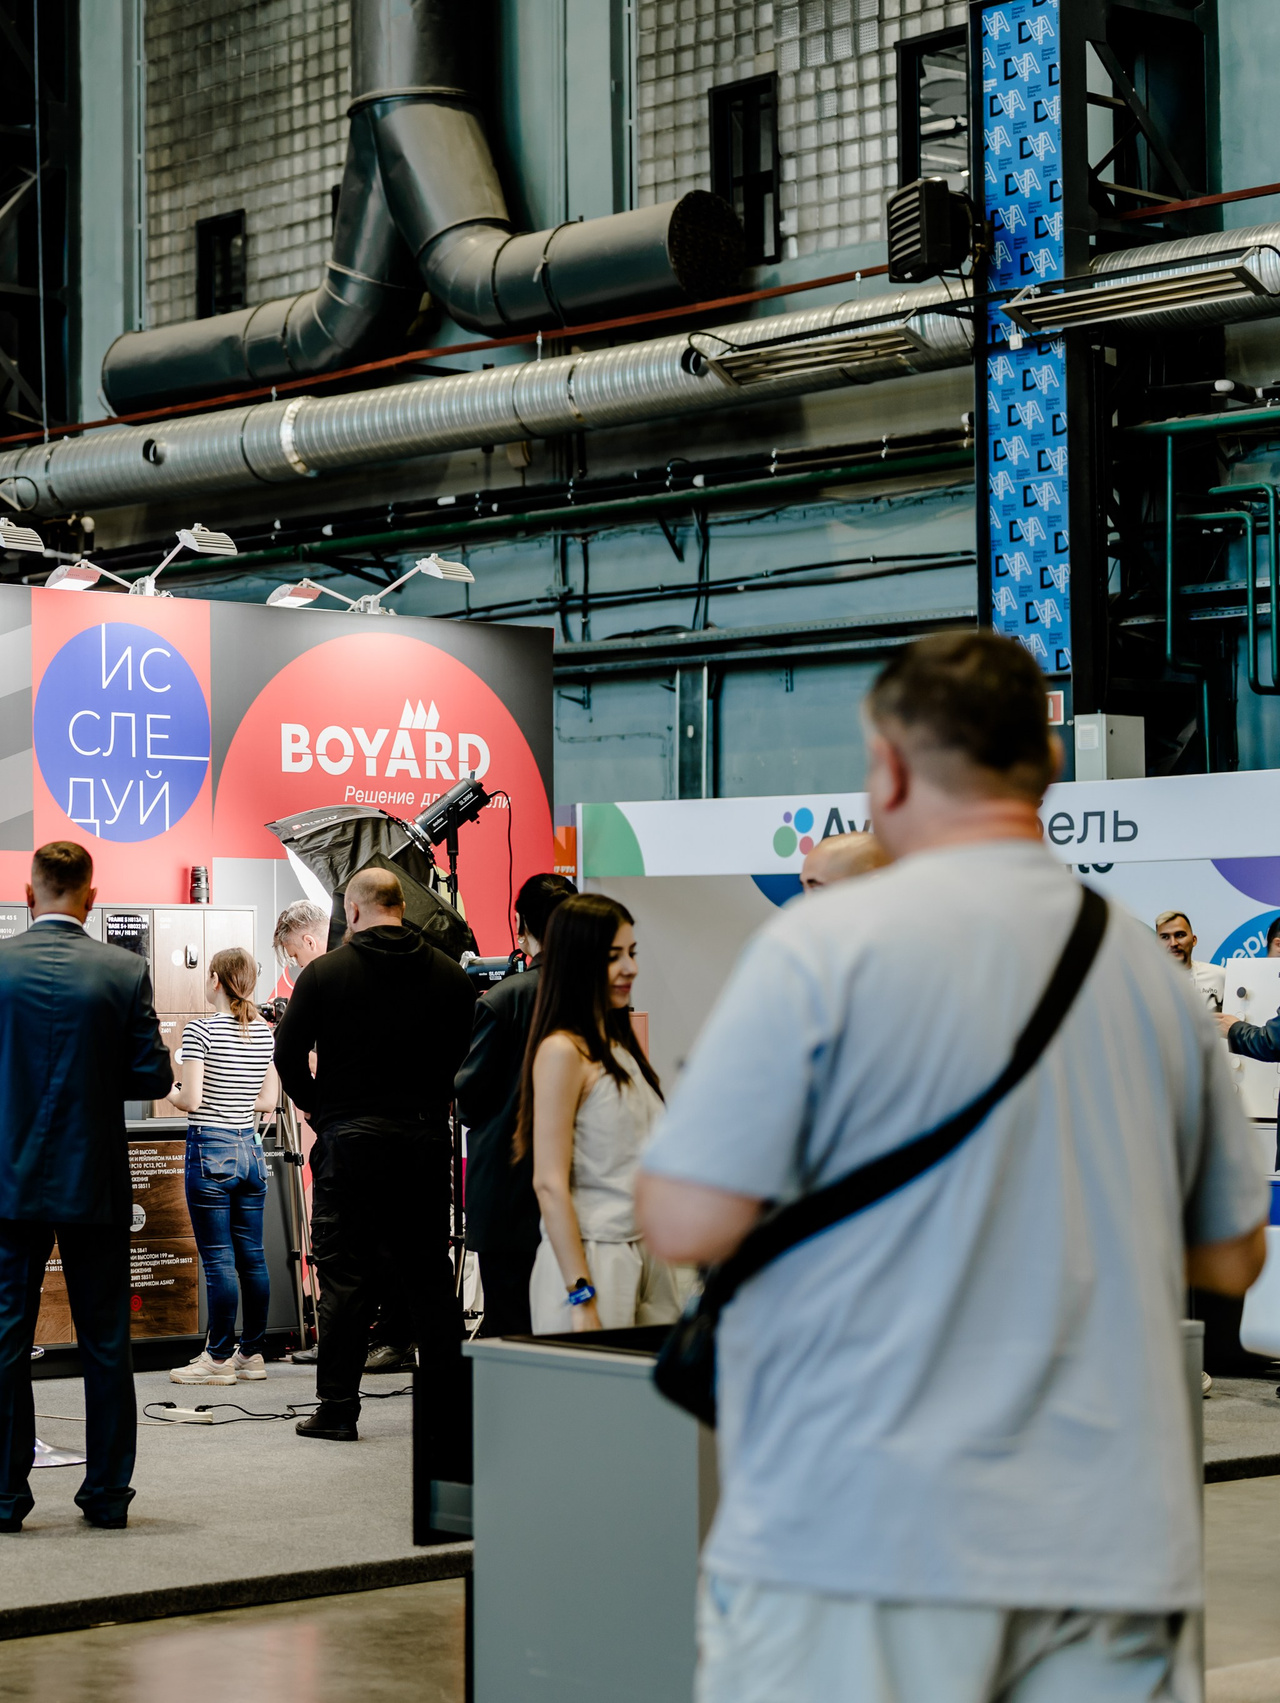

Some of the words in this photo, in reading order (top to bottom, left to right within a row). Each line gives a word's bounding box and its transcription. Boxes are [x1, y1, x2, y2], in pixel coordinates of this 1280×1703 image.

[101, 623, 172, 693] ИС
[68, 709, 210, 762] СЛЕ
[281, 721, 491, 780] BOYARD
[64, 768, 171, 838] ДУЙ
[344, 785, 415, 805] Решение
